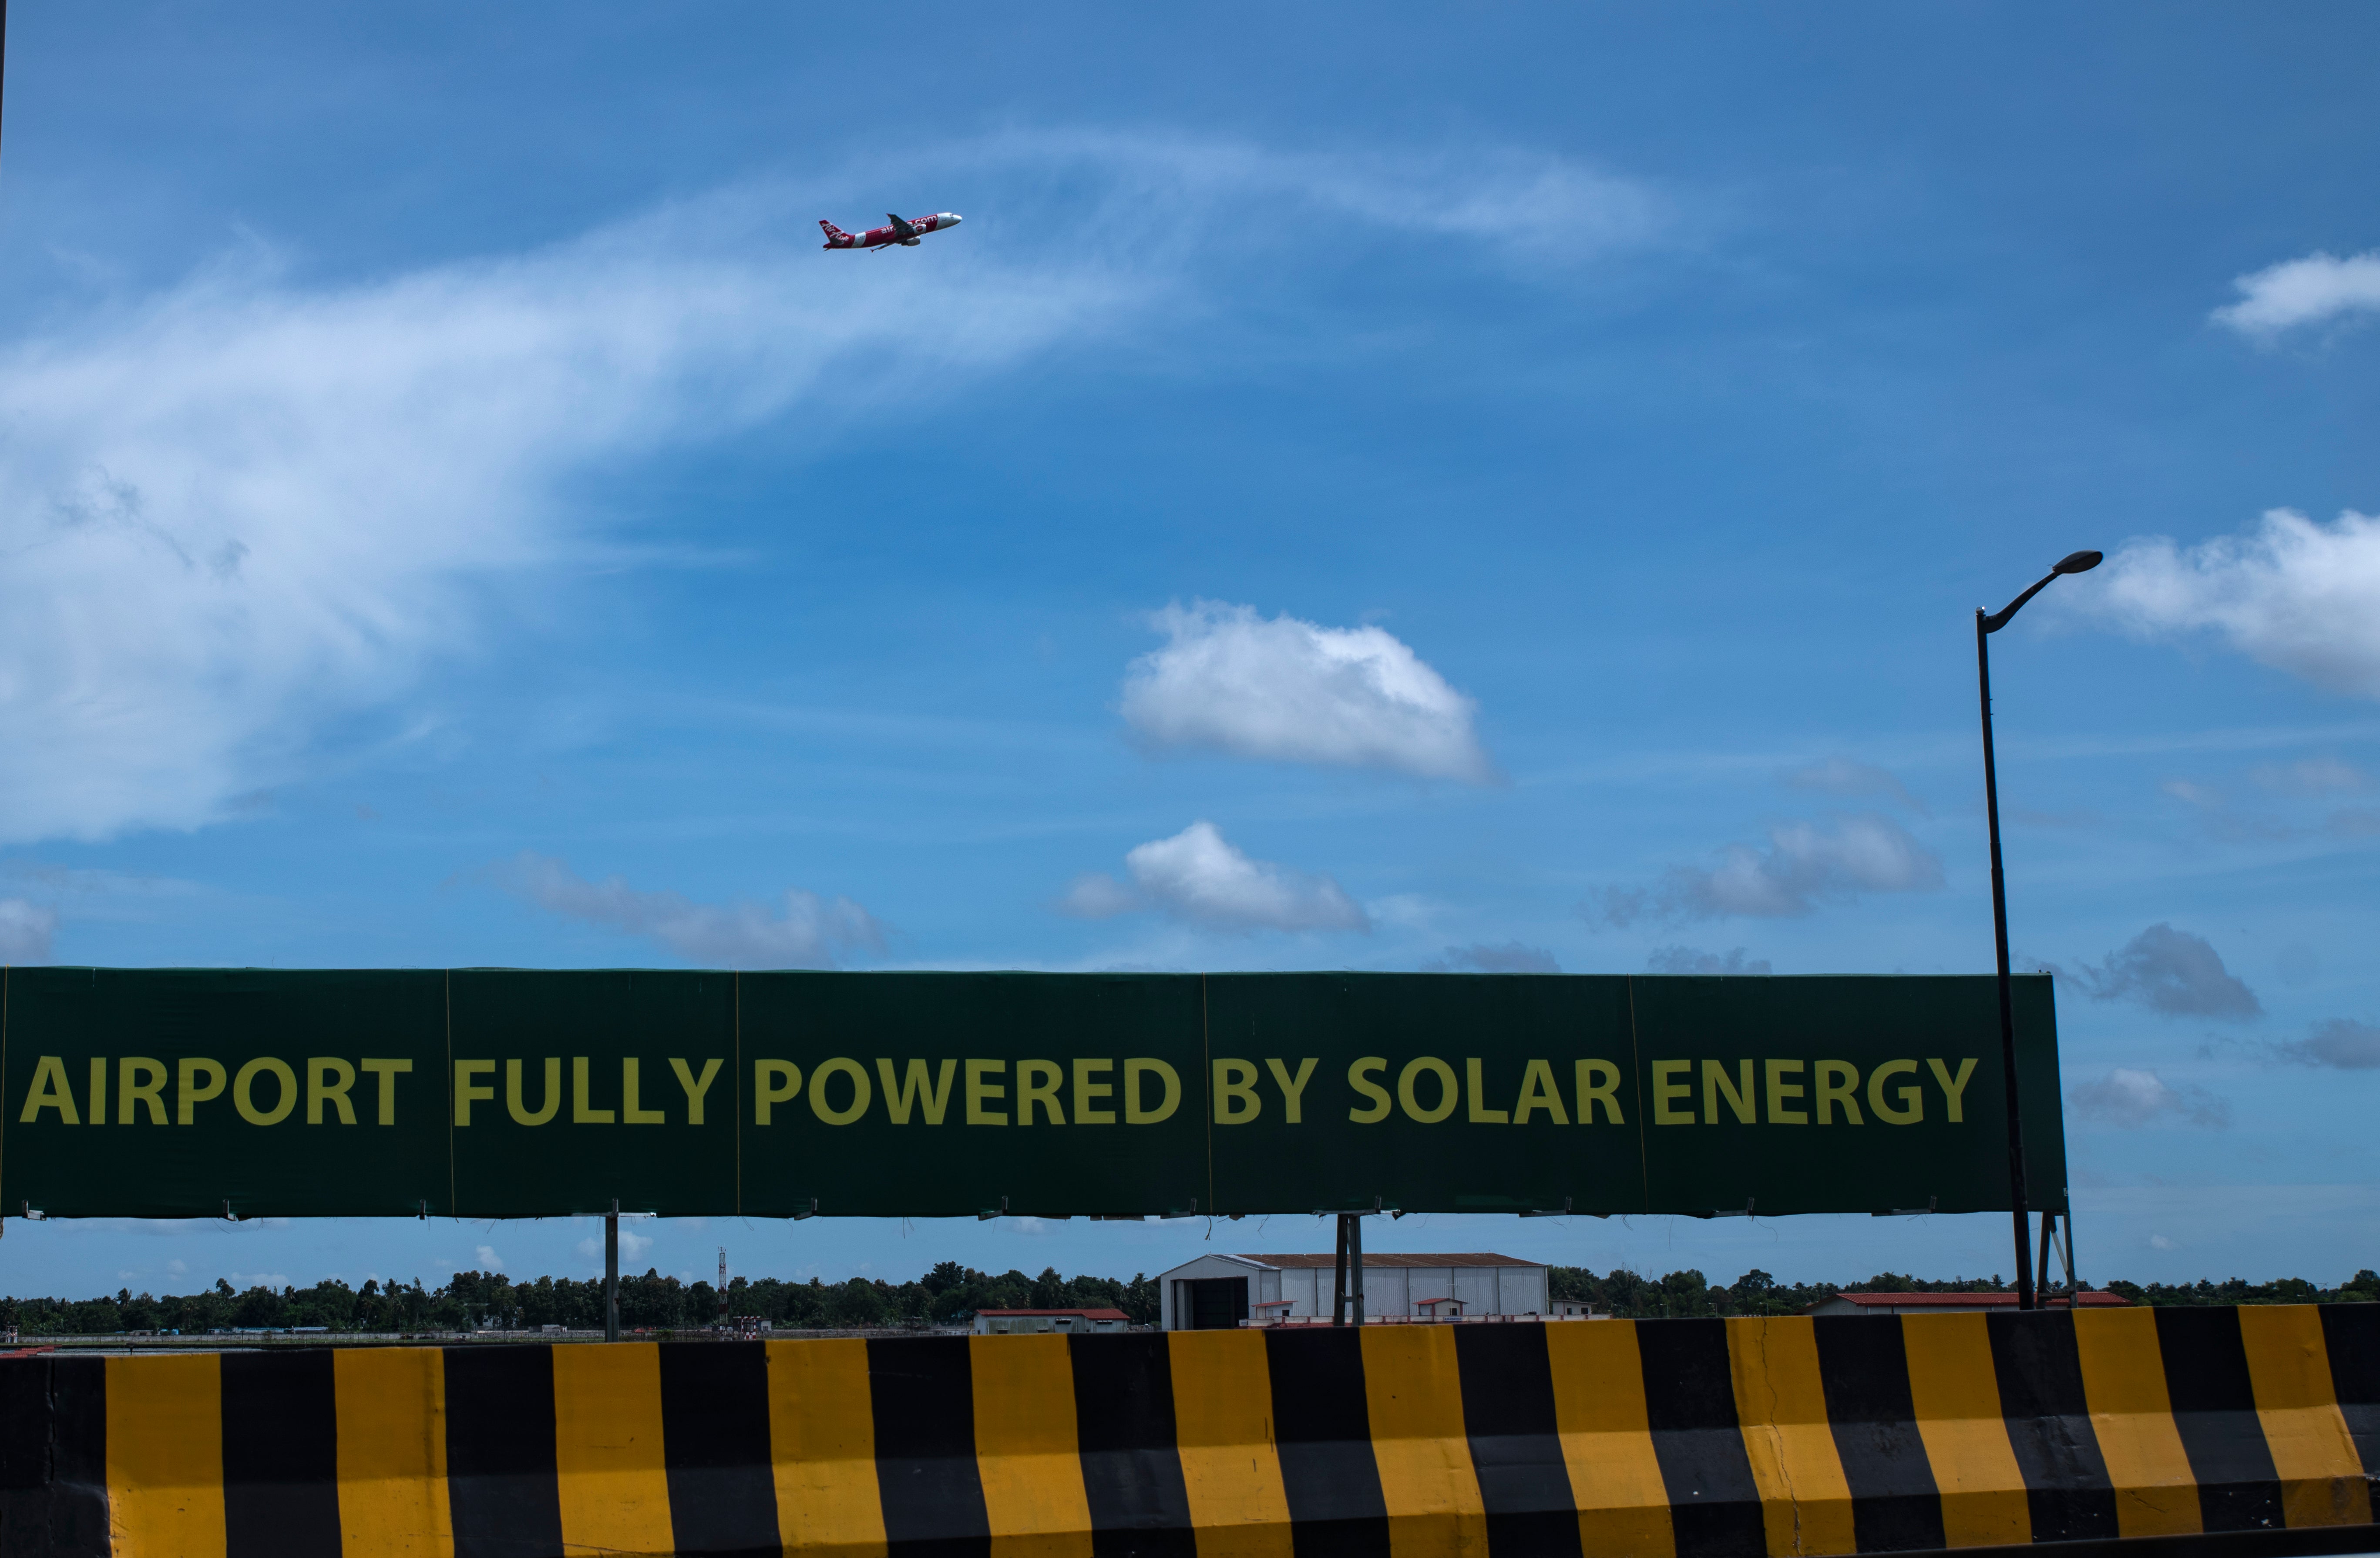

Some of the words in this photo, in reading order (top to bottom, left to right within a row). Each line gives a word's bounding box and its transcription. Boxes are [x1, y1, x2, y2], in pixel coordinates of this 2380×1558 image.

[20, 1057, 413, 1126] AIRPORT
[454, 1057, 724, 1126] FULLY
[755, 1058, 1181, 1125] POWERED
[1213, 1058, 1319, 1125] BY
[1348, 1056, 1624, 1125] SOLAR
[1652, 1058, 1978, 1125] ENERGY
